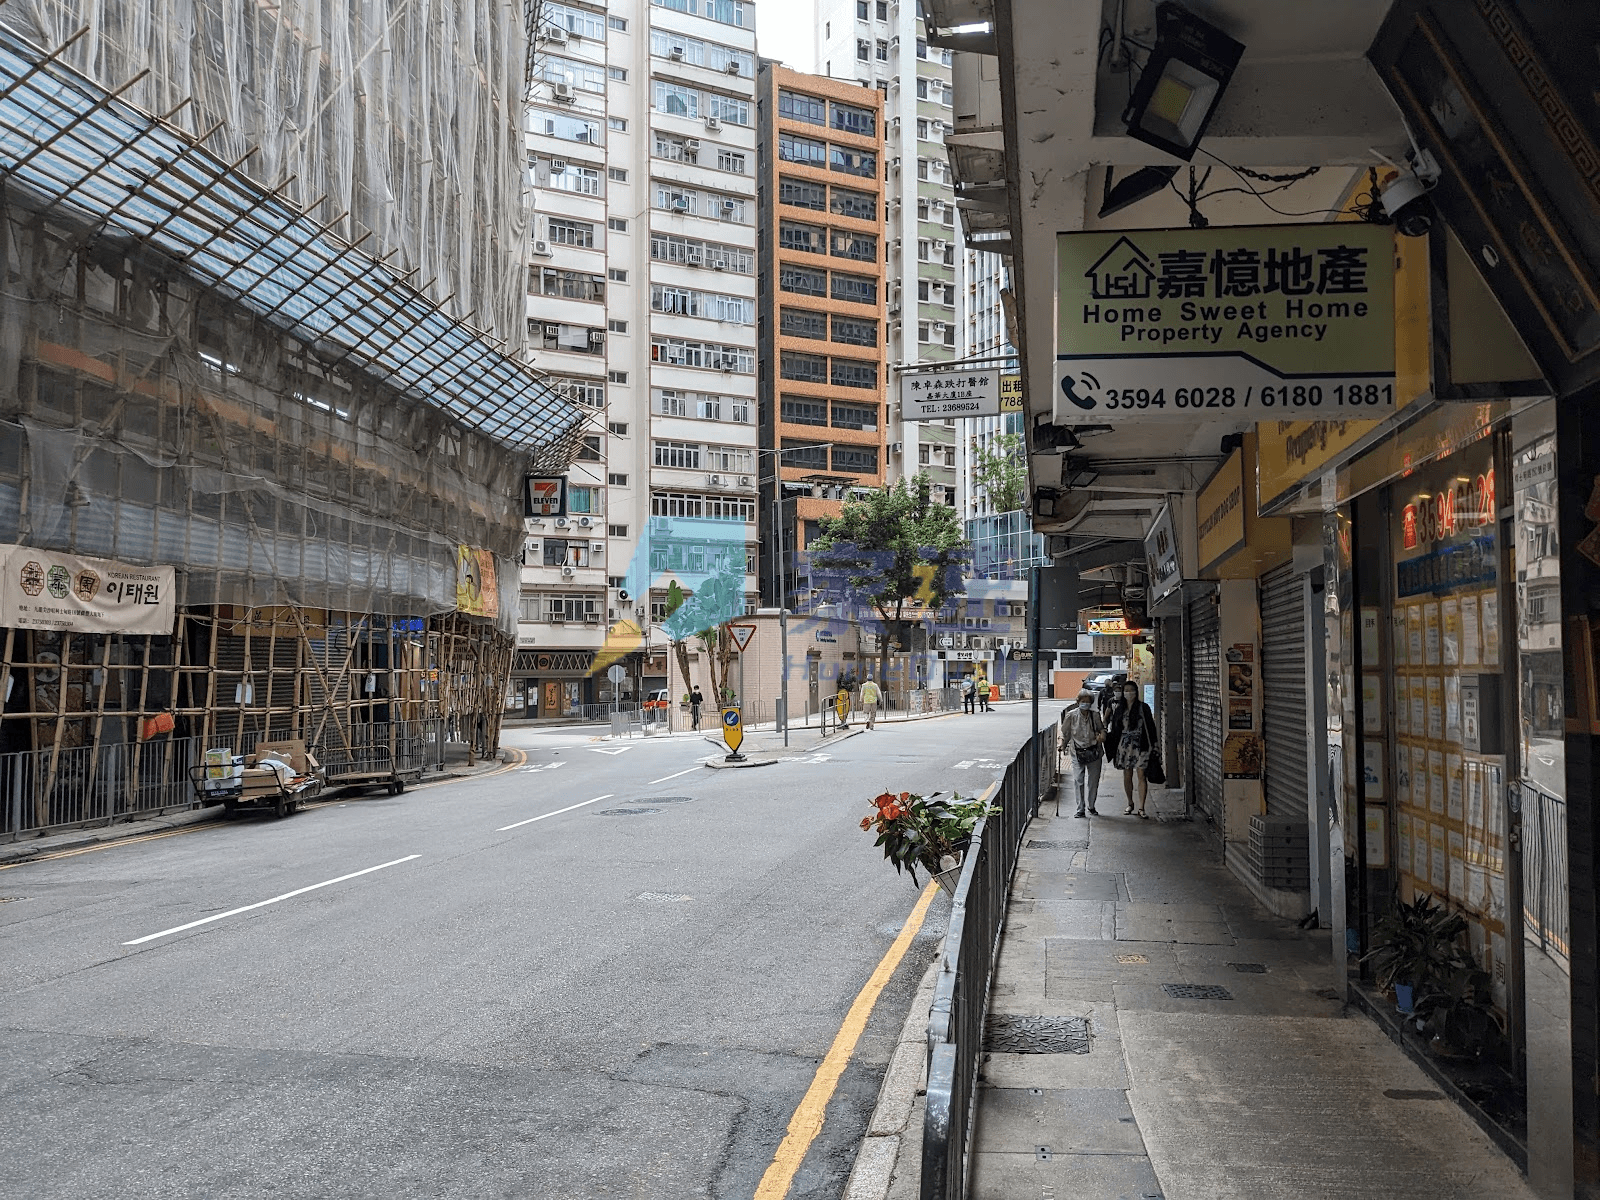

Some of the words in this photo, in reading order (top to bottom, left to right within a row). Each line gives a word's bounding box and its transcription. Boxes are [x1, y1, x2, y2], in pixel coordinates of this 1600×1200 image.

[1157, 245, 1368, 299] 嘉憶地產
[1083, 304, 1162, 324] Home
[1181, 301, 1267, 321] Sweet
[1286, 299, 1368, 318] Home
[1121, 324, 1223, 344] Property
[1237, 321, 1327, 342] Agency
[1105, 388, 1166, 410] 3594
[1174, 387, 1236, 408] 6028
[1244, 386, 1252, 408] /
[1260, 385, 1323, 407] 6180
[1333, 383, 1393, 405] 1881
[921, 405, 940, 413] TEL:
[107, 572, 129, 580] KOREAN
[129, 574, 160, 582] RESTAURANT
[107, 582, 159, 604] 이태원
